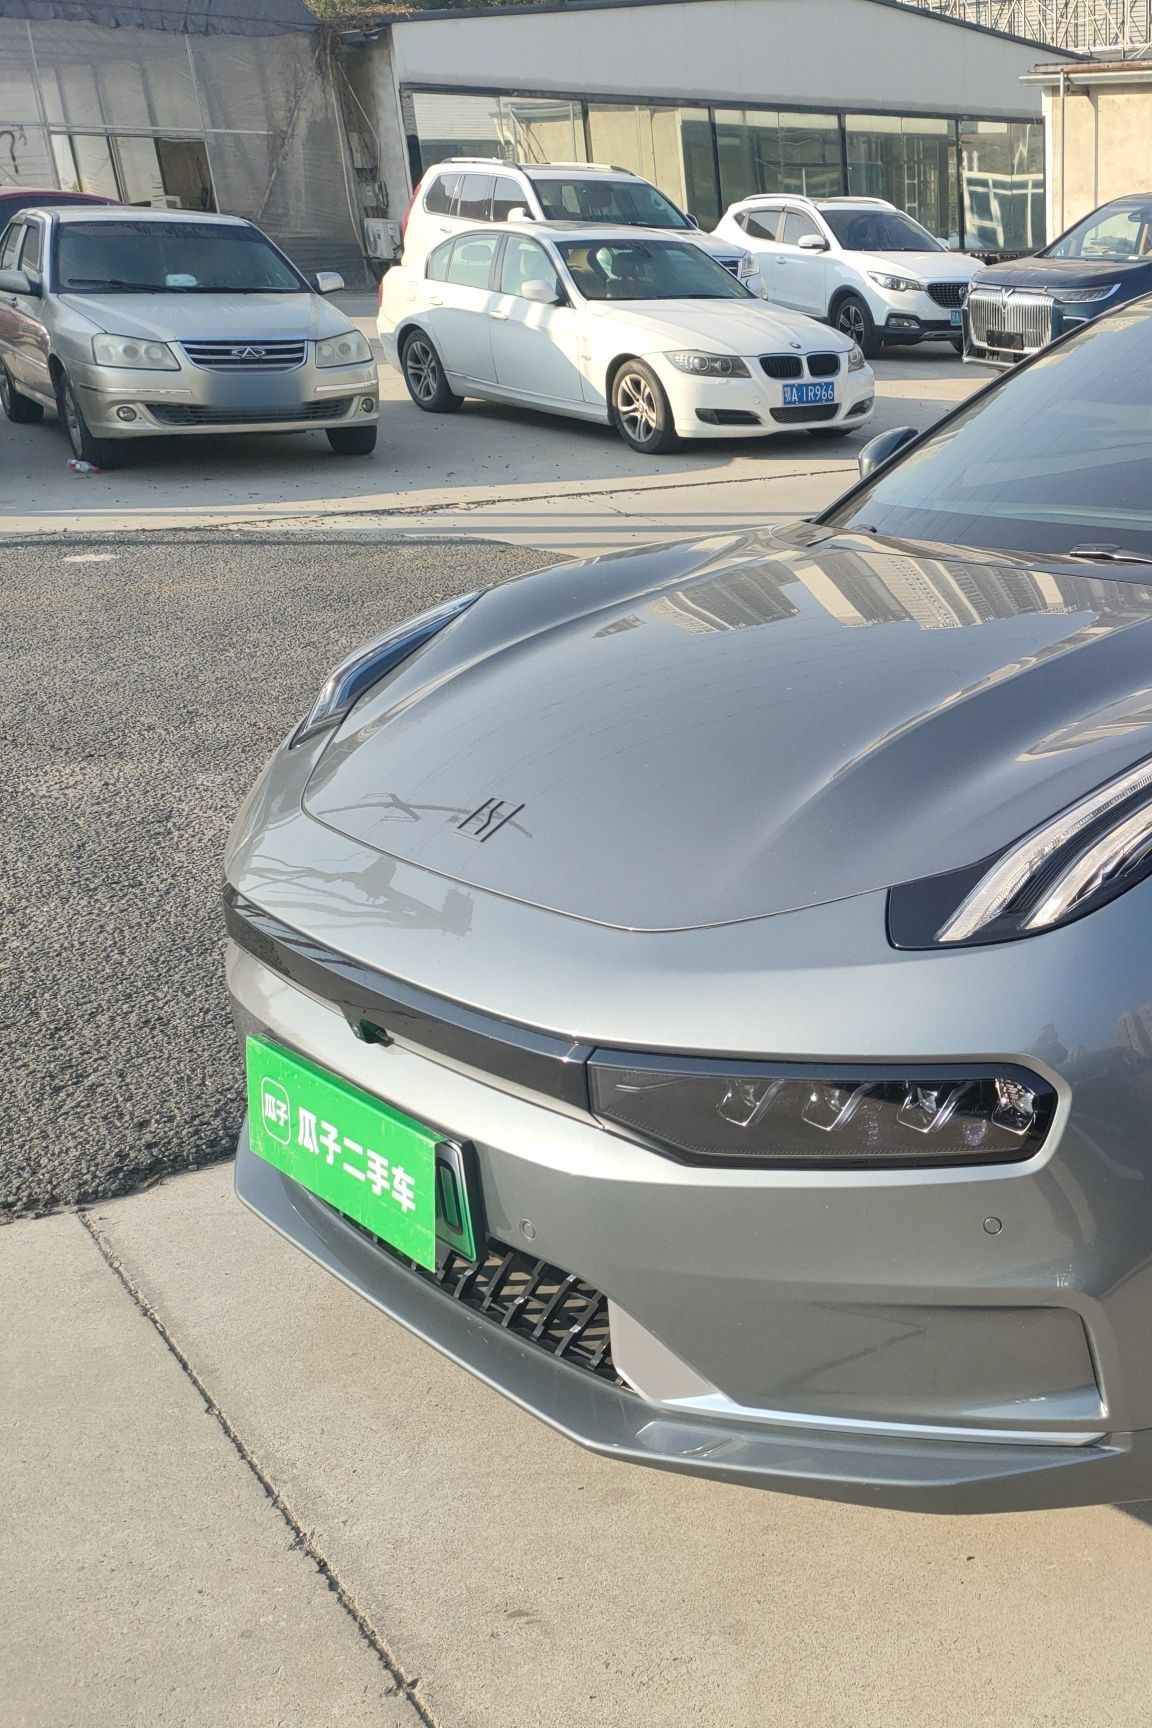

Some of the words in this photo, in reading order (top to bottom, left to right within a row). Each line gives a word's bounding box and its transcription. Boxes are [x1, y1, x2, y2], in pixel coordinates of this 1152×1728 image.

[264, 1092, 289, 1128] 瓜子
[298, 1106, 416, 1213] 瓜子二手车
